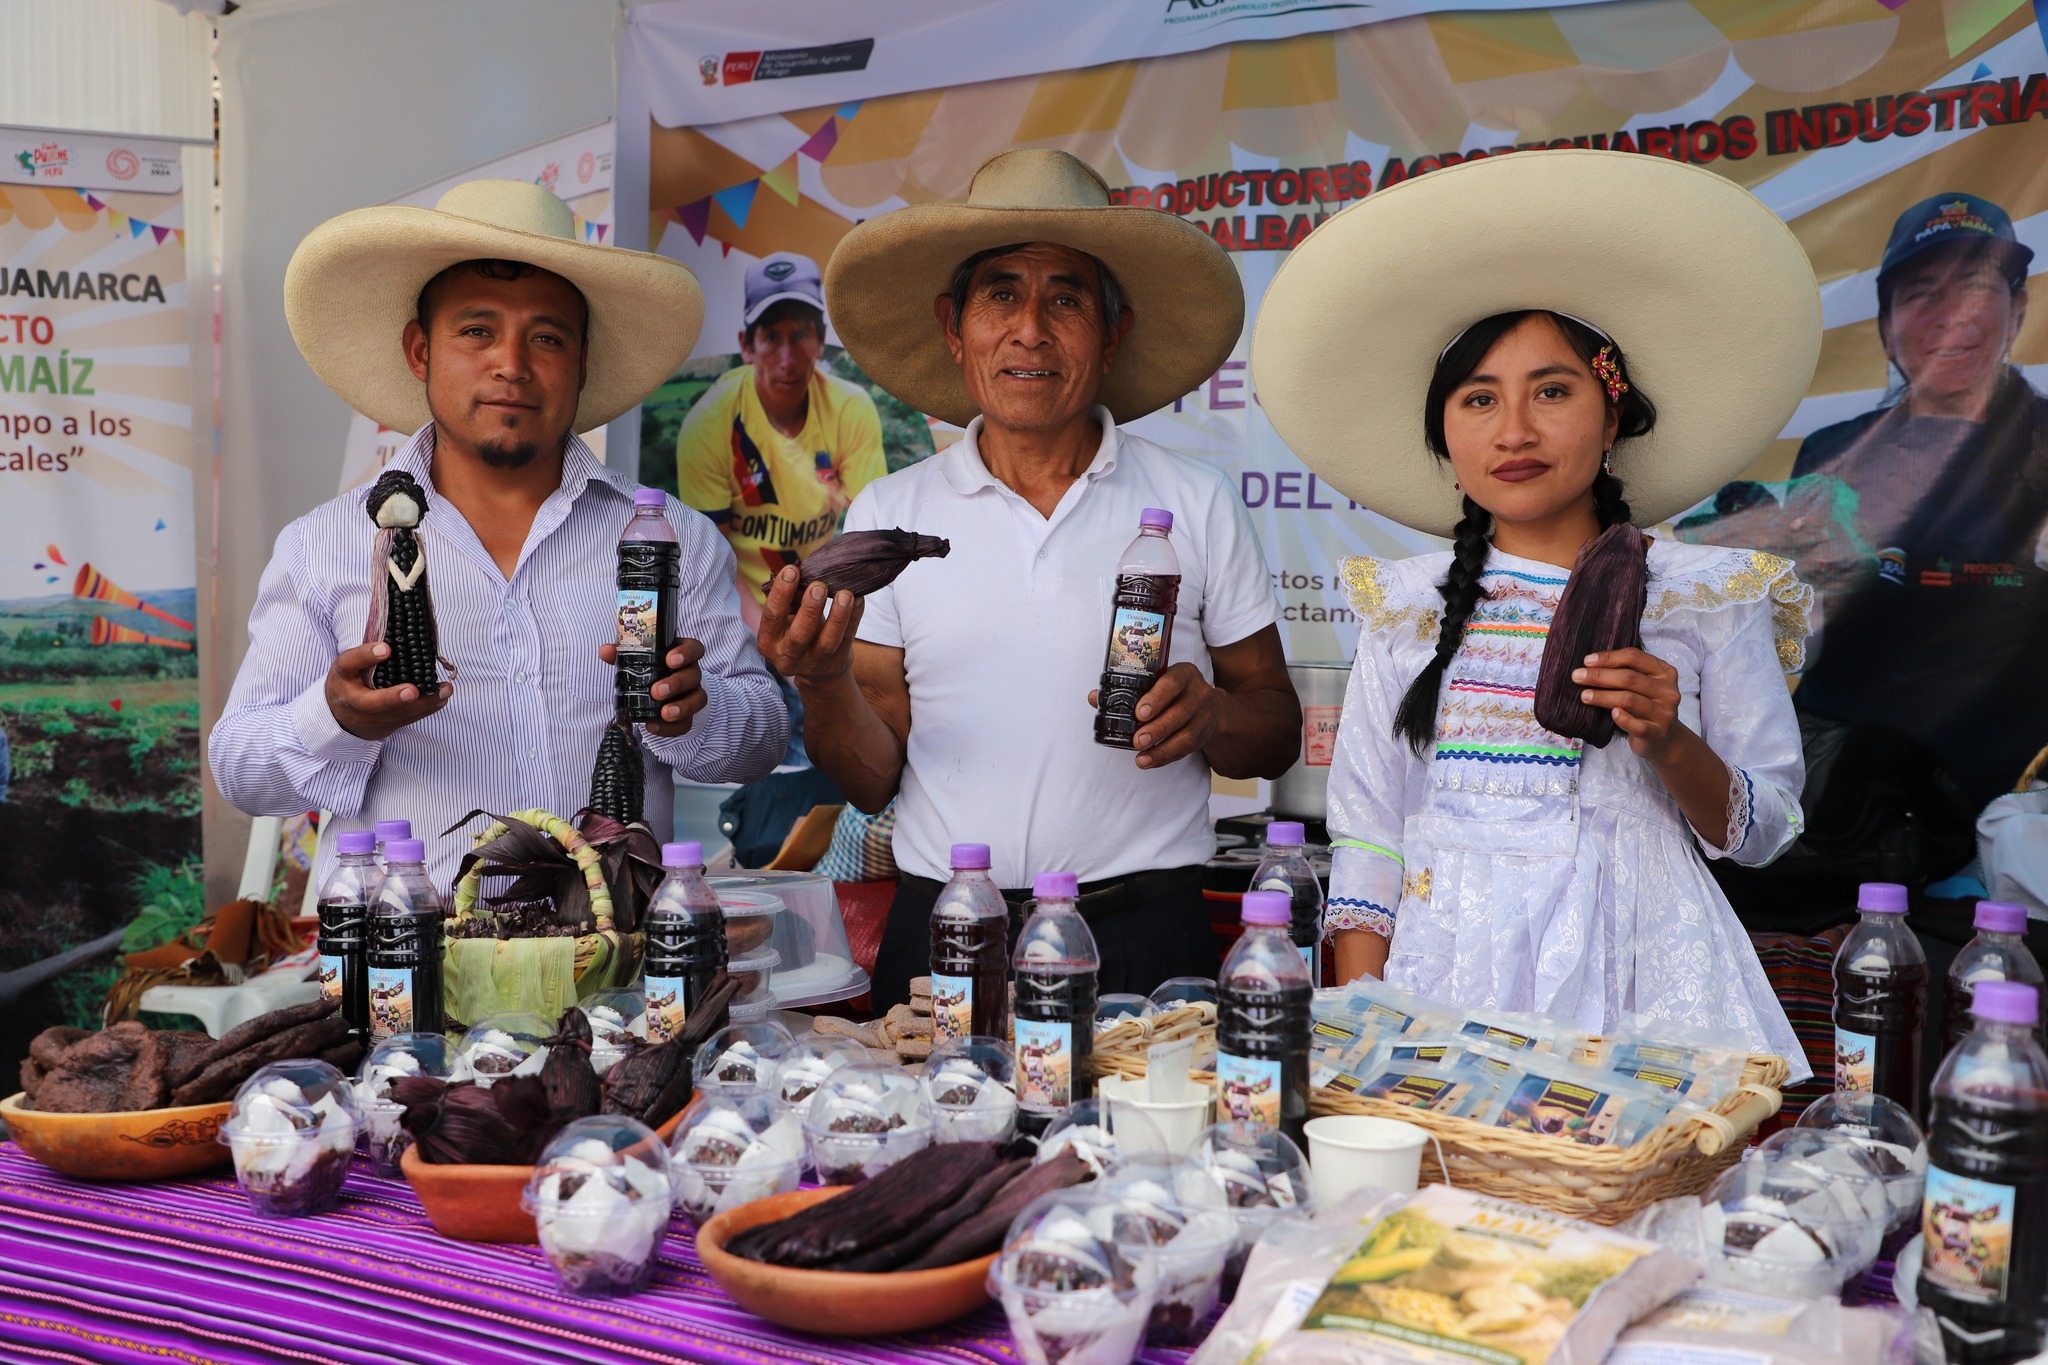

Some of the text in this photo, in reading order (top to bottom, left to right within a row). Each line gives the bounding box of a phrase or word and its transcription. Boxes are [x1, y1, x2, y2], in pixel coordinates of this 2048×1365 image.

[62, 416, 78, 435] a
[90, 410, 131, 436] los
[1242, 472, 1332, 509] DEL
